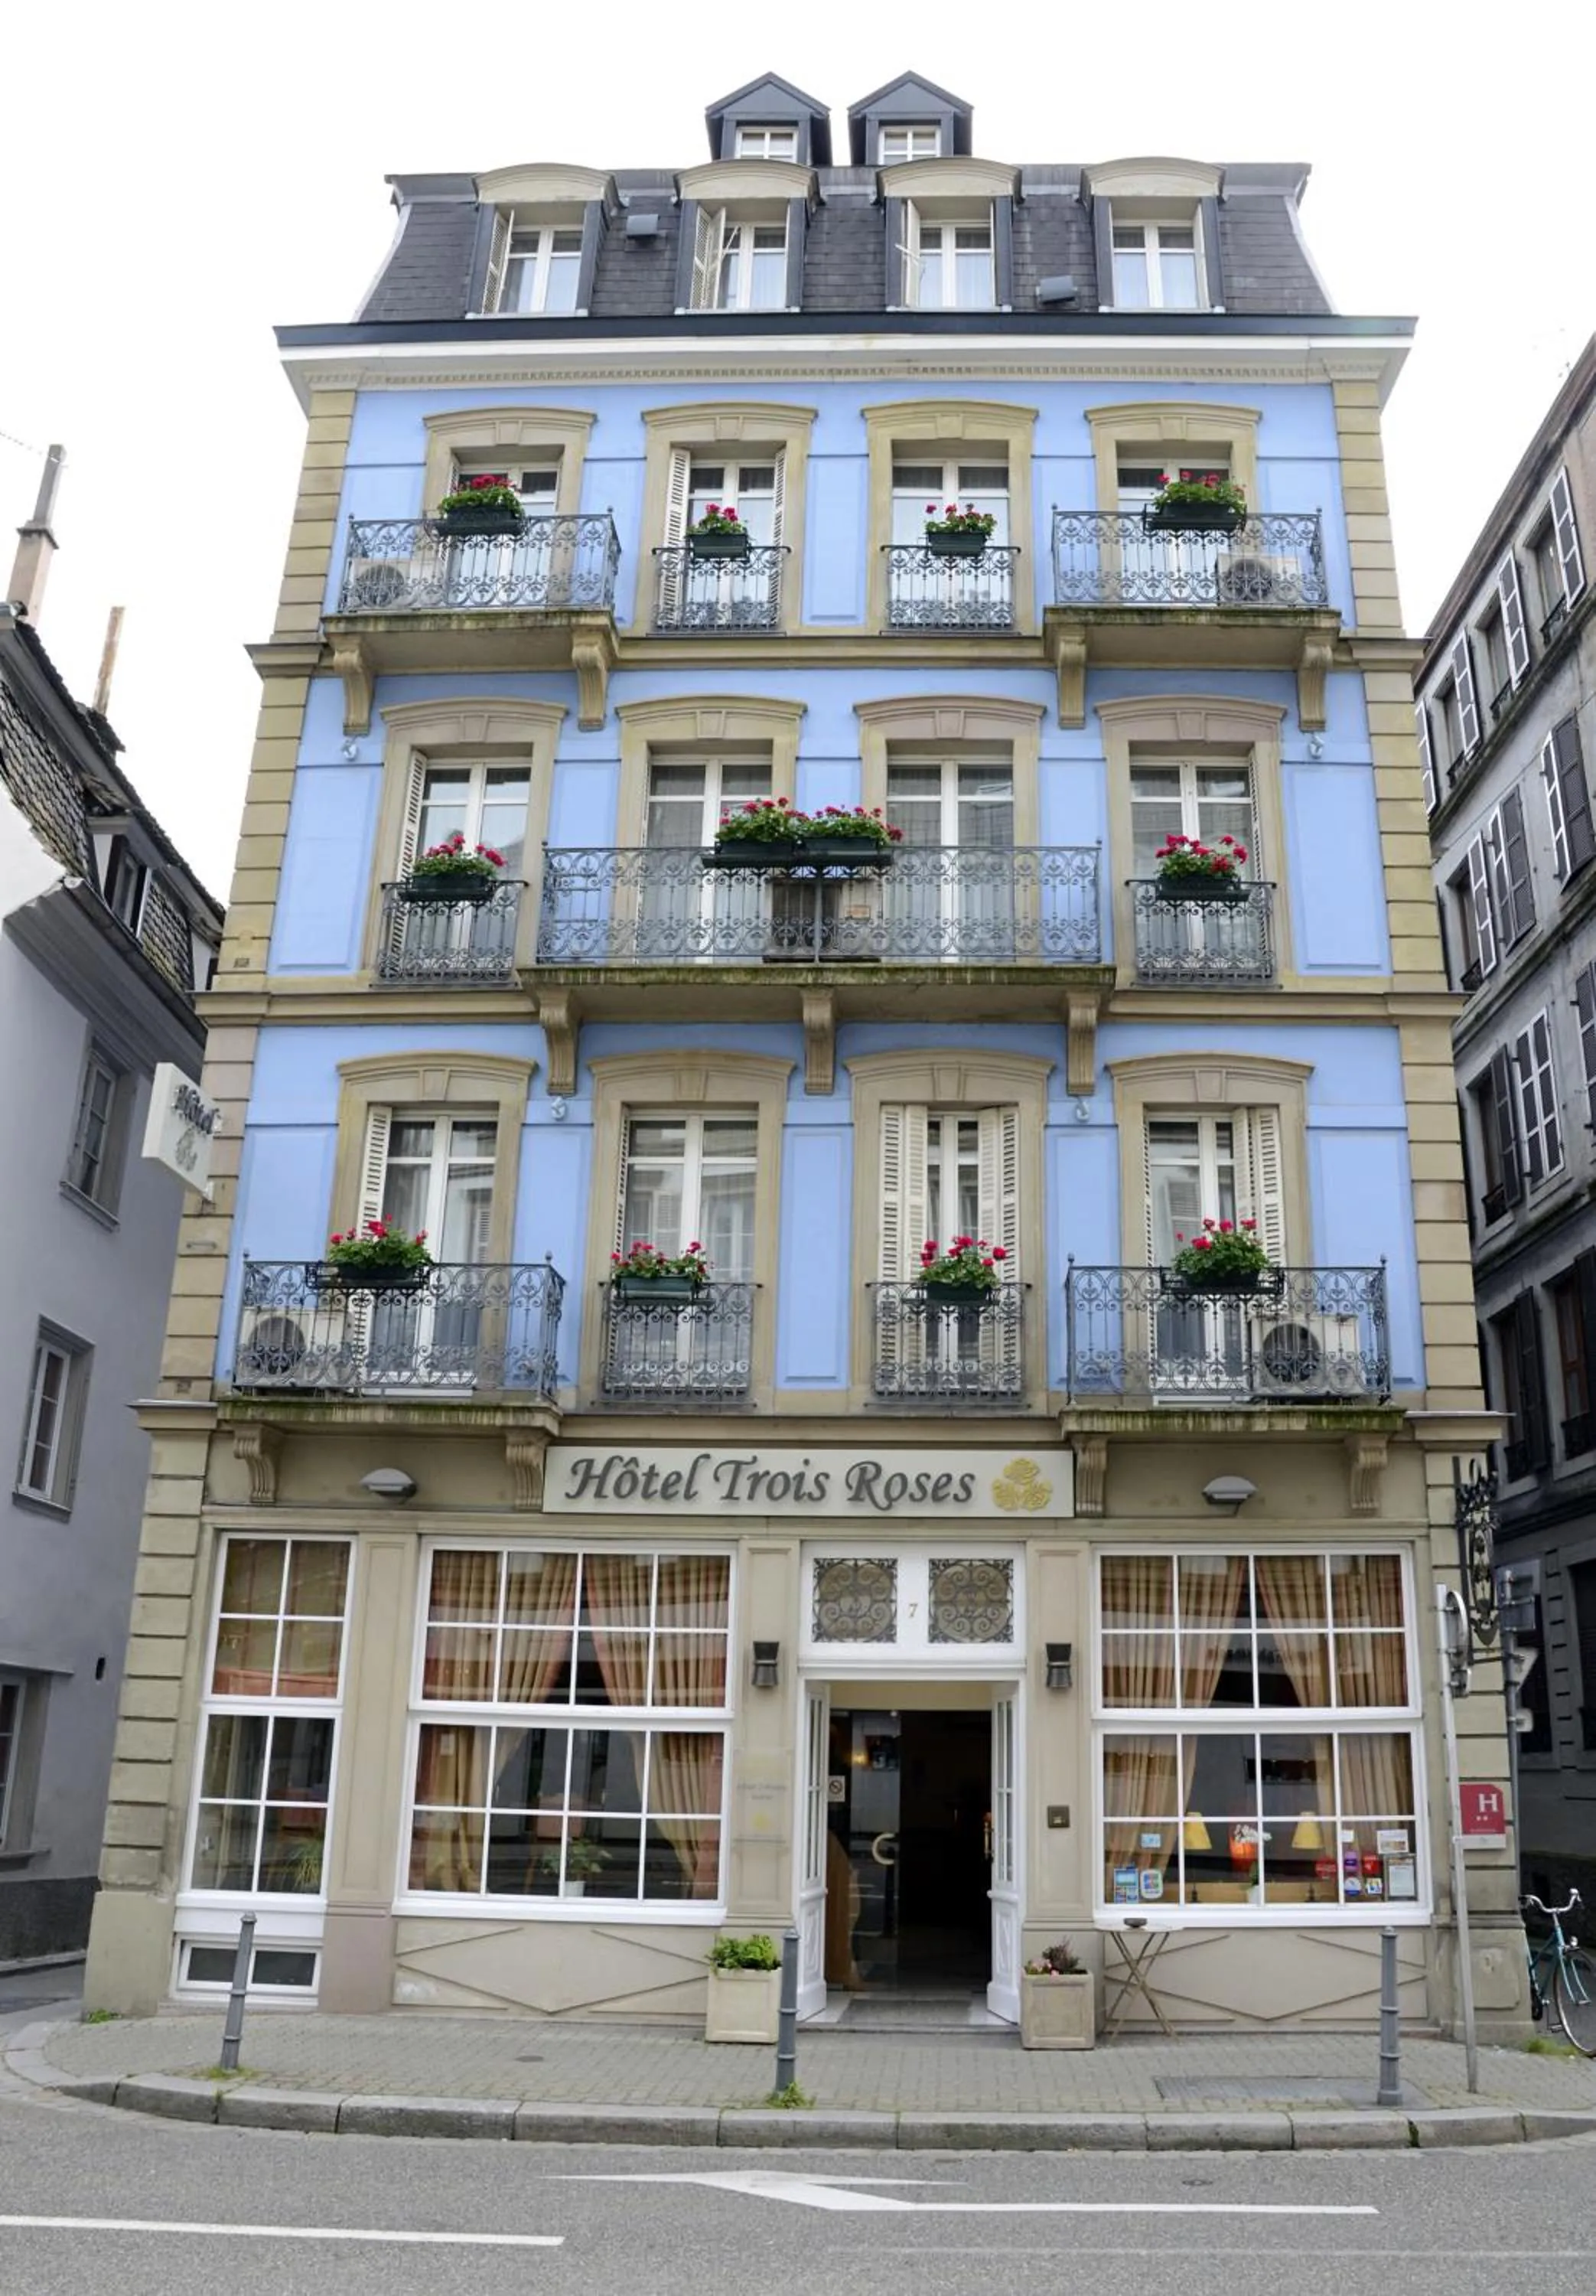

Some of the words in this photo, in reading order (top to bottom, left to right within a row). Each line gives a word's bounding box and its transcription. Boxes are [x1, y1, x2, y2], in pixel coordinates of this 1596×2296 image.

[565, 1453, 711, 1500] Hôtel
[713, 1455, 831, 1502] Trois
[845, 1460, 976, 1511] Roses
[908, 1603, 918, 1618] 7
[1478, 1793, 1499, 1813] H
